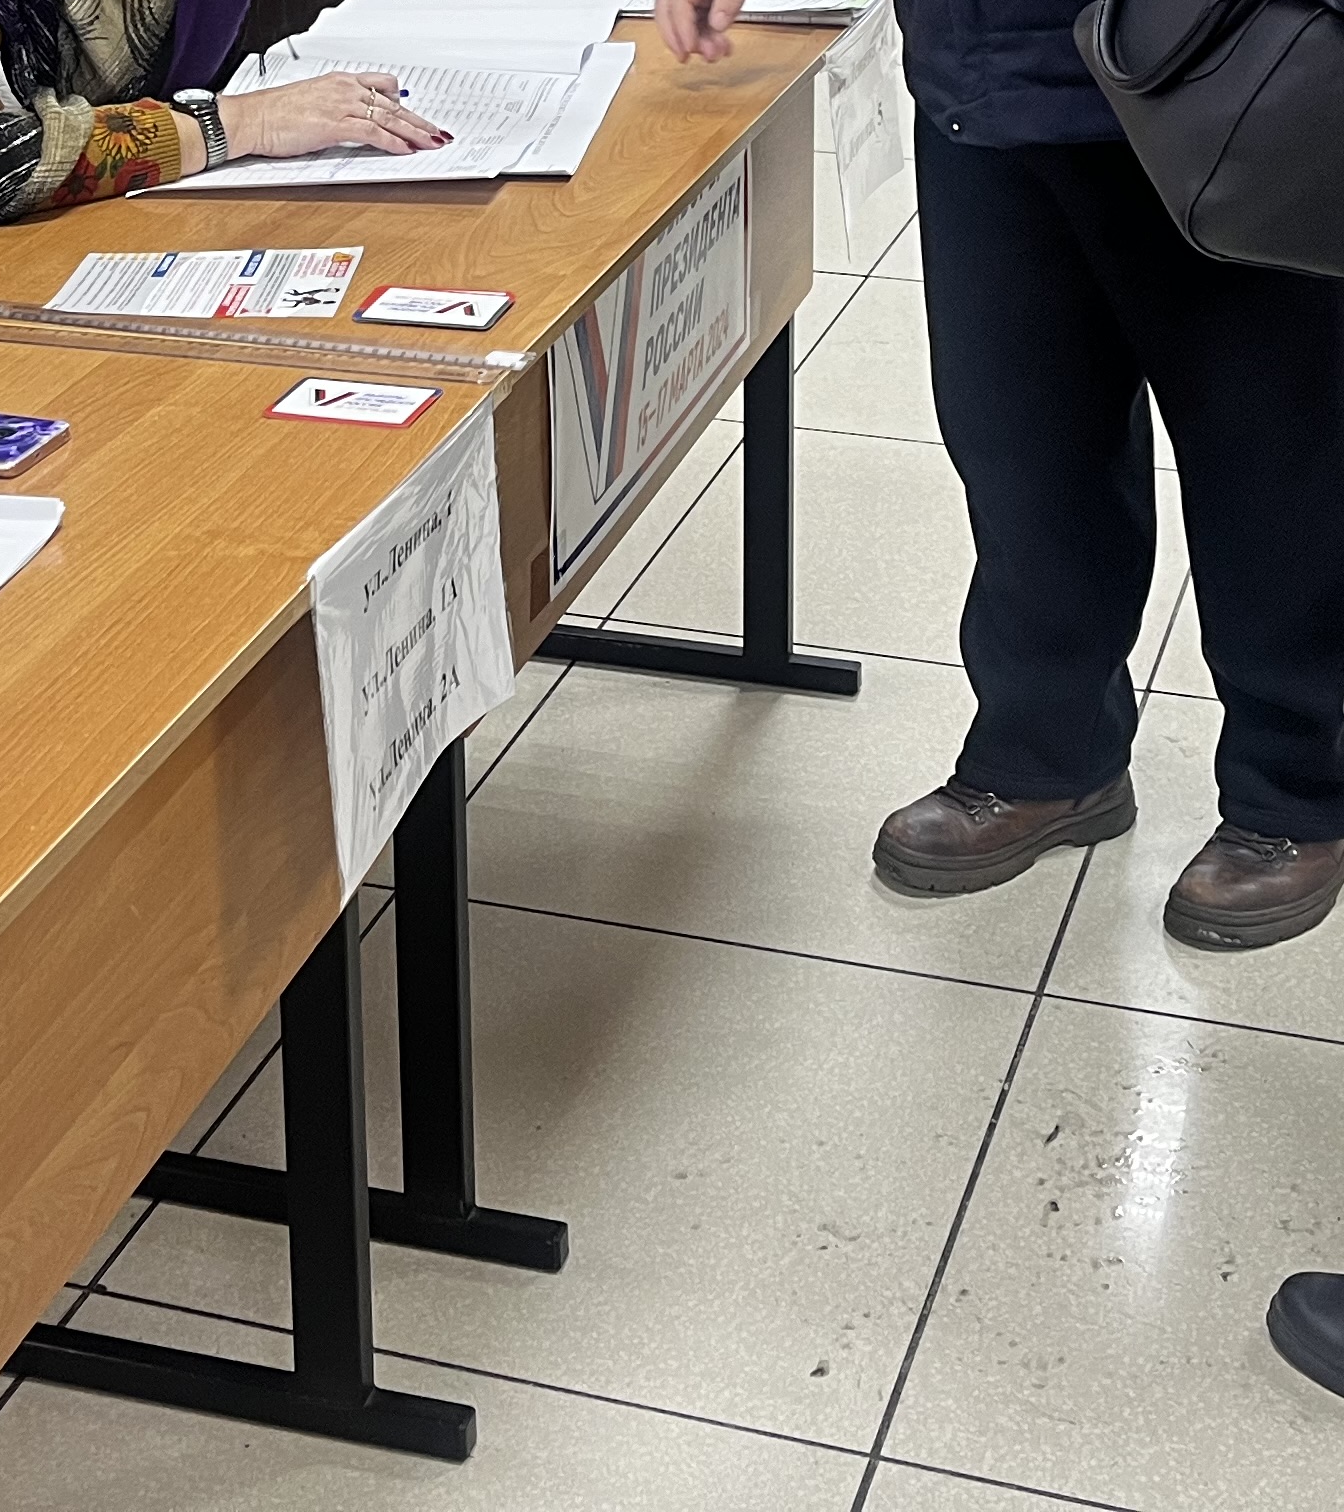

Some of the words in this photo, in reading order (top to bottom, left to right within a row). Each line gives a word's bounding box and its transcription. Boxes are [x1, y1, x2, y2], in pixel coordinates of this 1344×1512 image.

[649, 176, 741, 318] ПРЕЗИДЕНТА
[642, 277, 705, 391] РОССИИ
[668, 345, 705, 414] МАРТА
[705, 301, 730, 368] 2024
[440, 575, 459, 614] 1А
